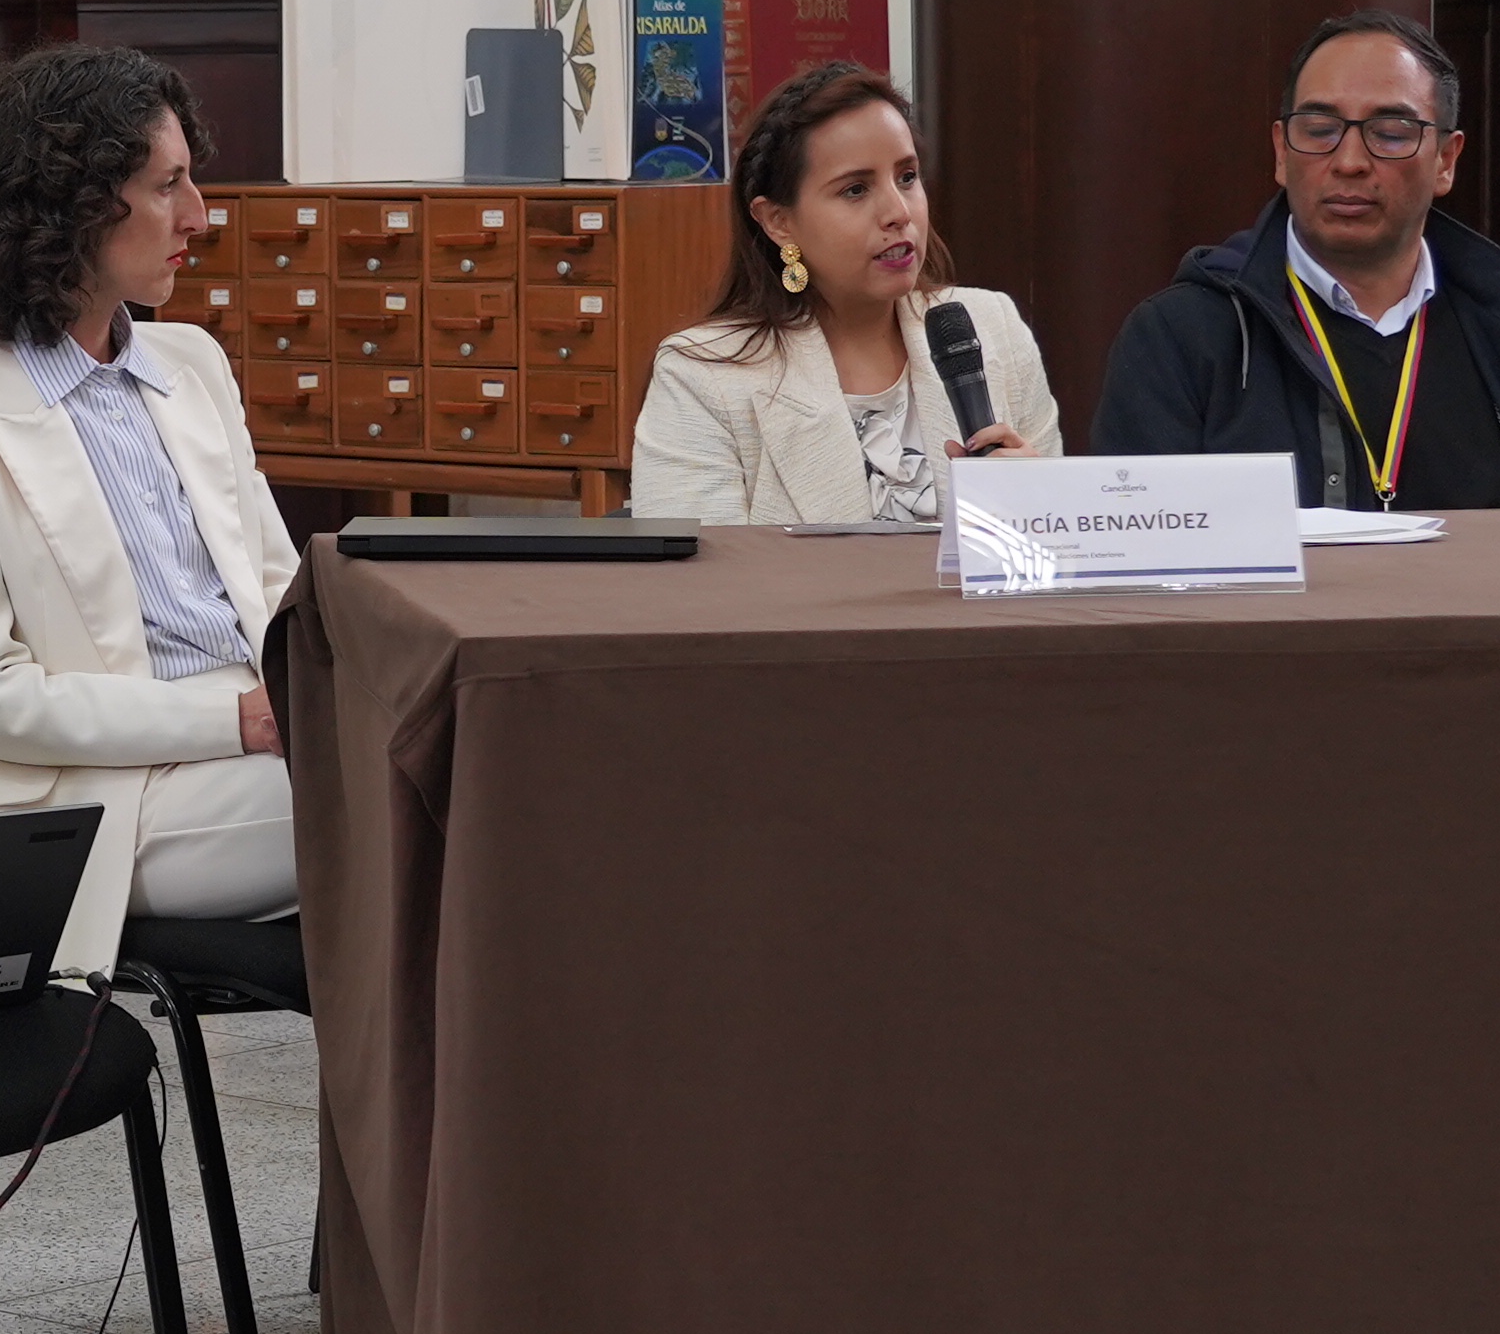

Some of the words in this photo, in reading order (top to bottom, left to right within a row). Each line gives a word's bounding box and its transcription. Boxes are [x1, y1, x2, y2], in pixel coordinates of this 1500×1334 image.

[653, 0, 673, 12] Atlas
[674, 0, 686, 12] de
[1100, 483, 1147, 493] Cancillería
[1001, 512, 1069, 534] UCÍA
[1076, 509, 1210, 533] BENAVÍDEZ
